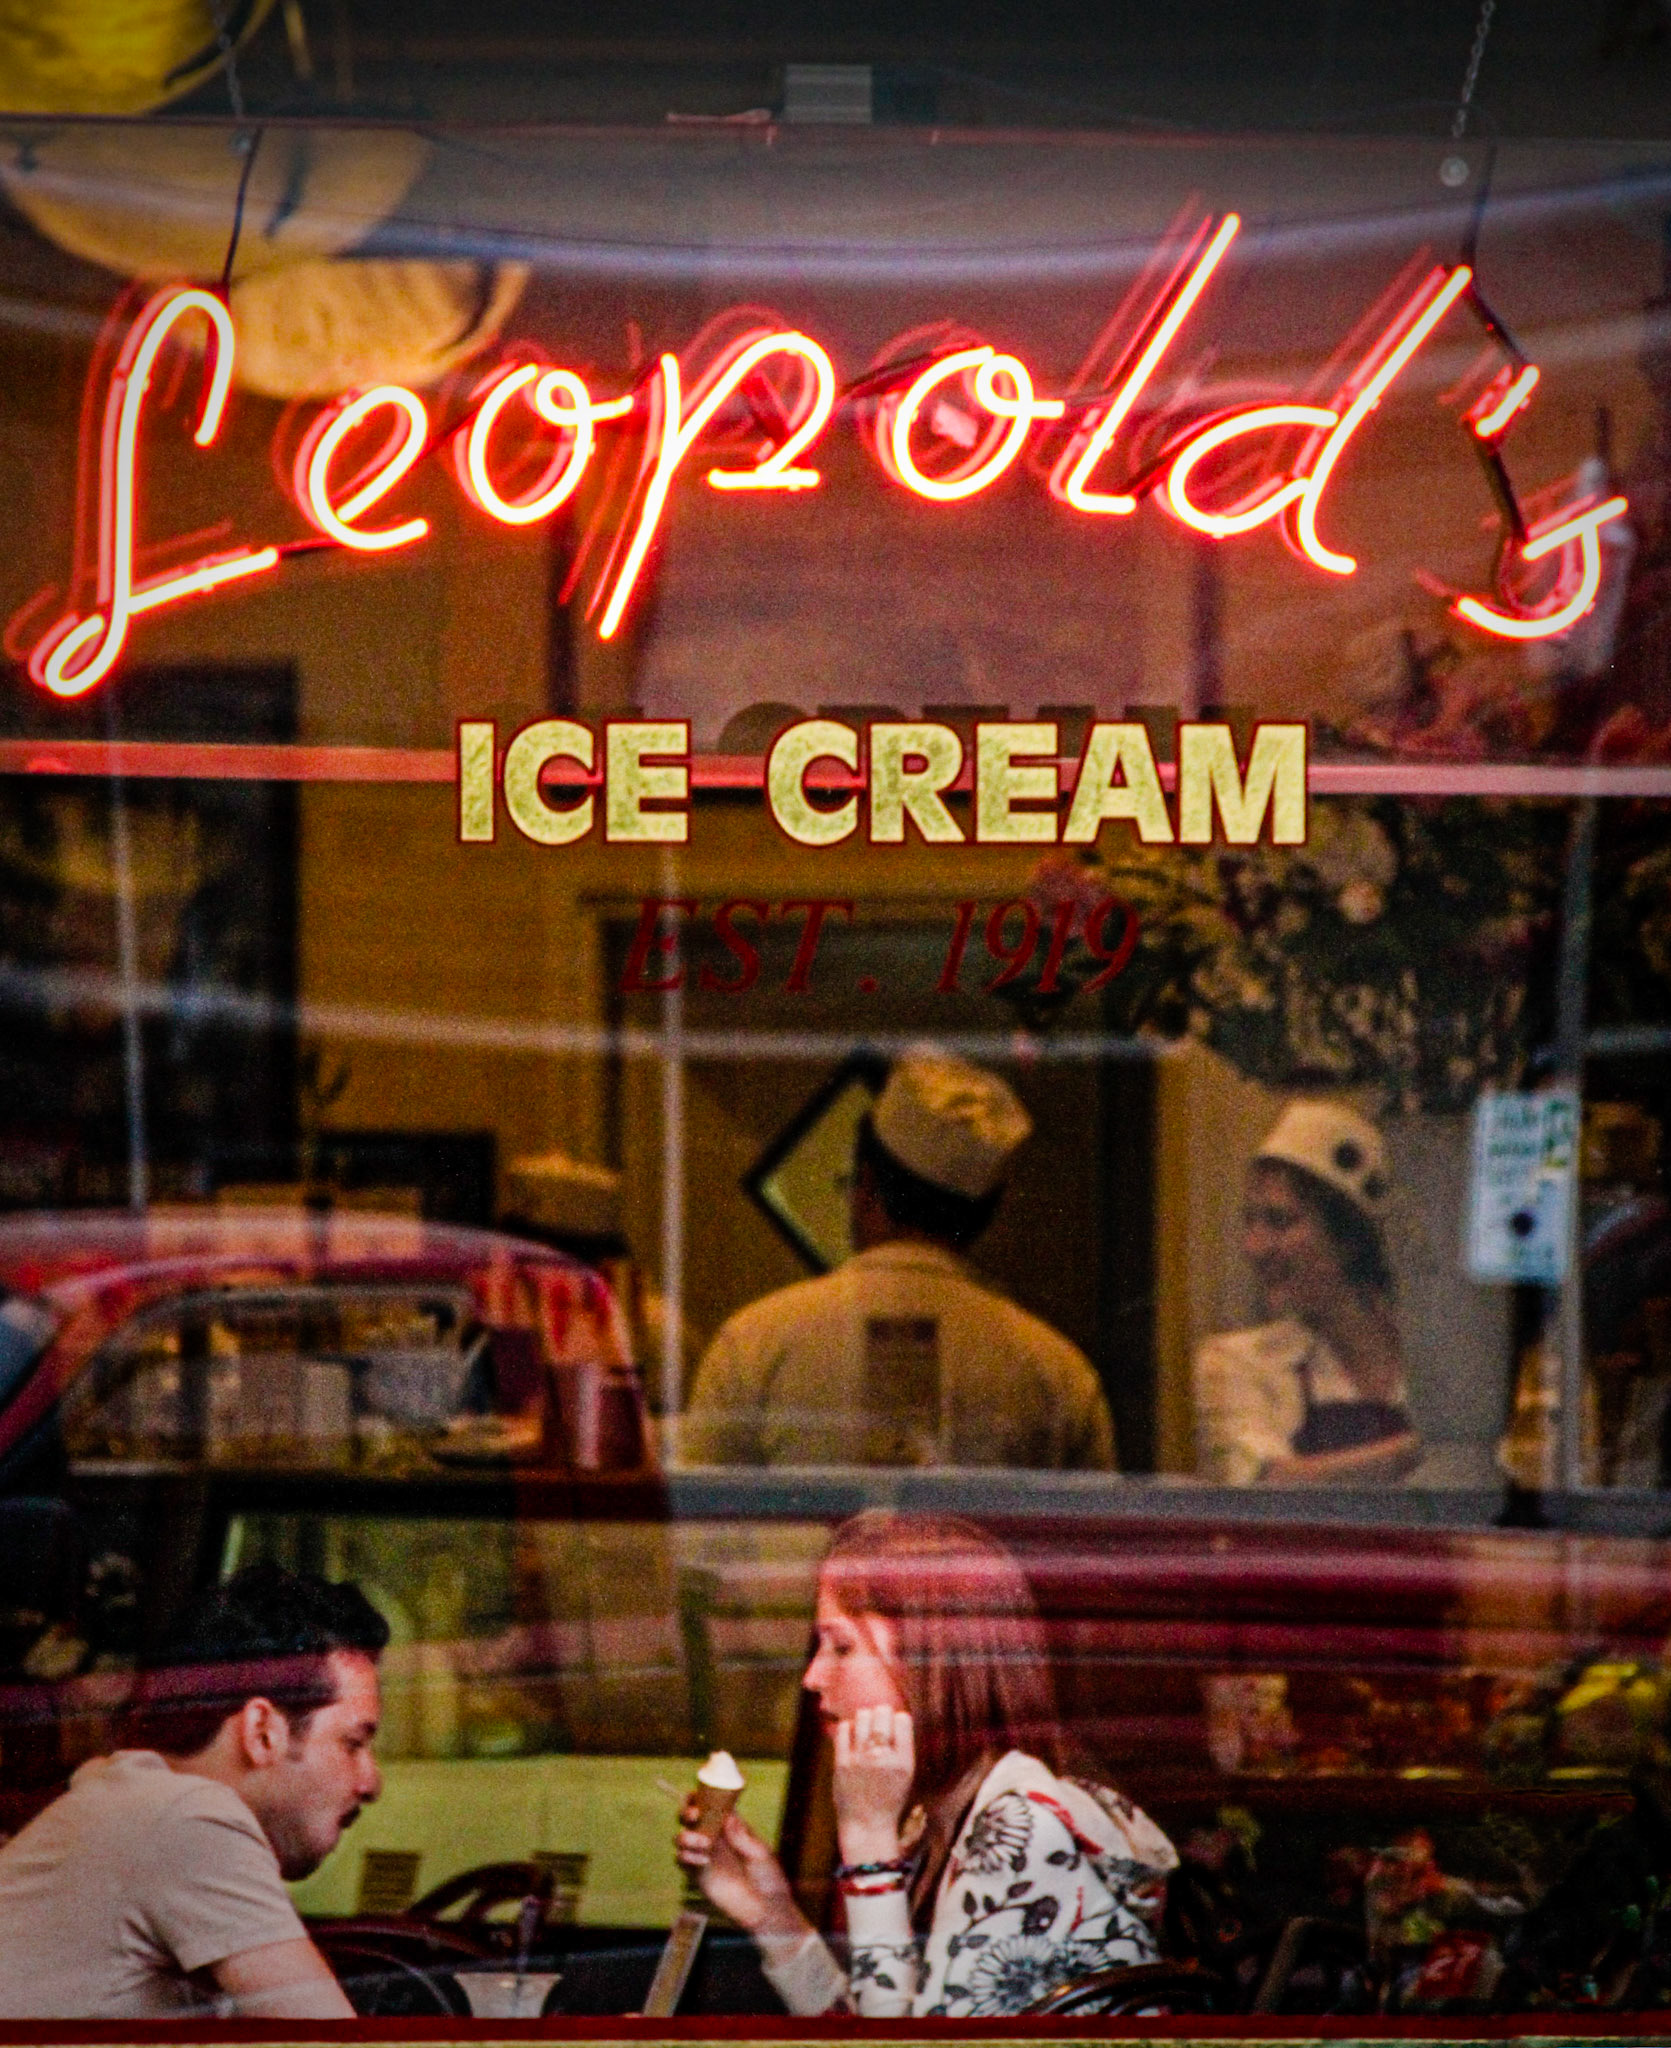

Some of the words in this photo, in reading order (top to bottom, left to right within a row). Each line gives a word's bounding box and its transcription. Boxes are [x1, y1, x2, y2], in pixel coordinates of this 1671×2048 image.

[29, 212, 1628, 698] Leopold's
[457, 719, 691, 846] ICE
[764, 719, 1309, 846] CREAM
[619, 897, 878, 994] EST.
[933, 897, 1141, 994] 1919
